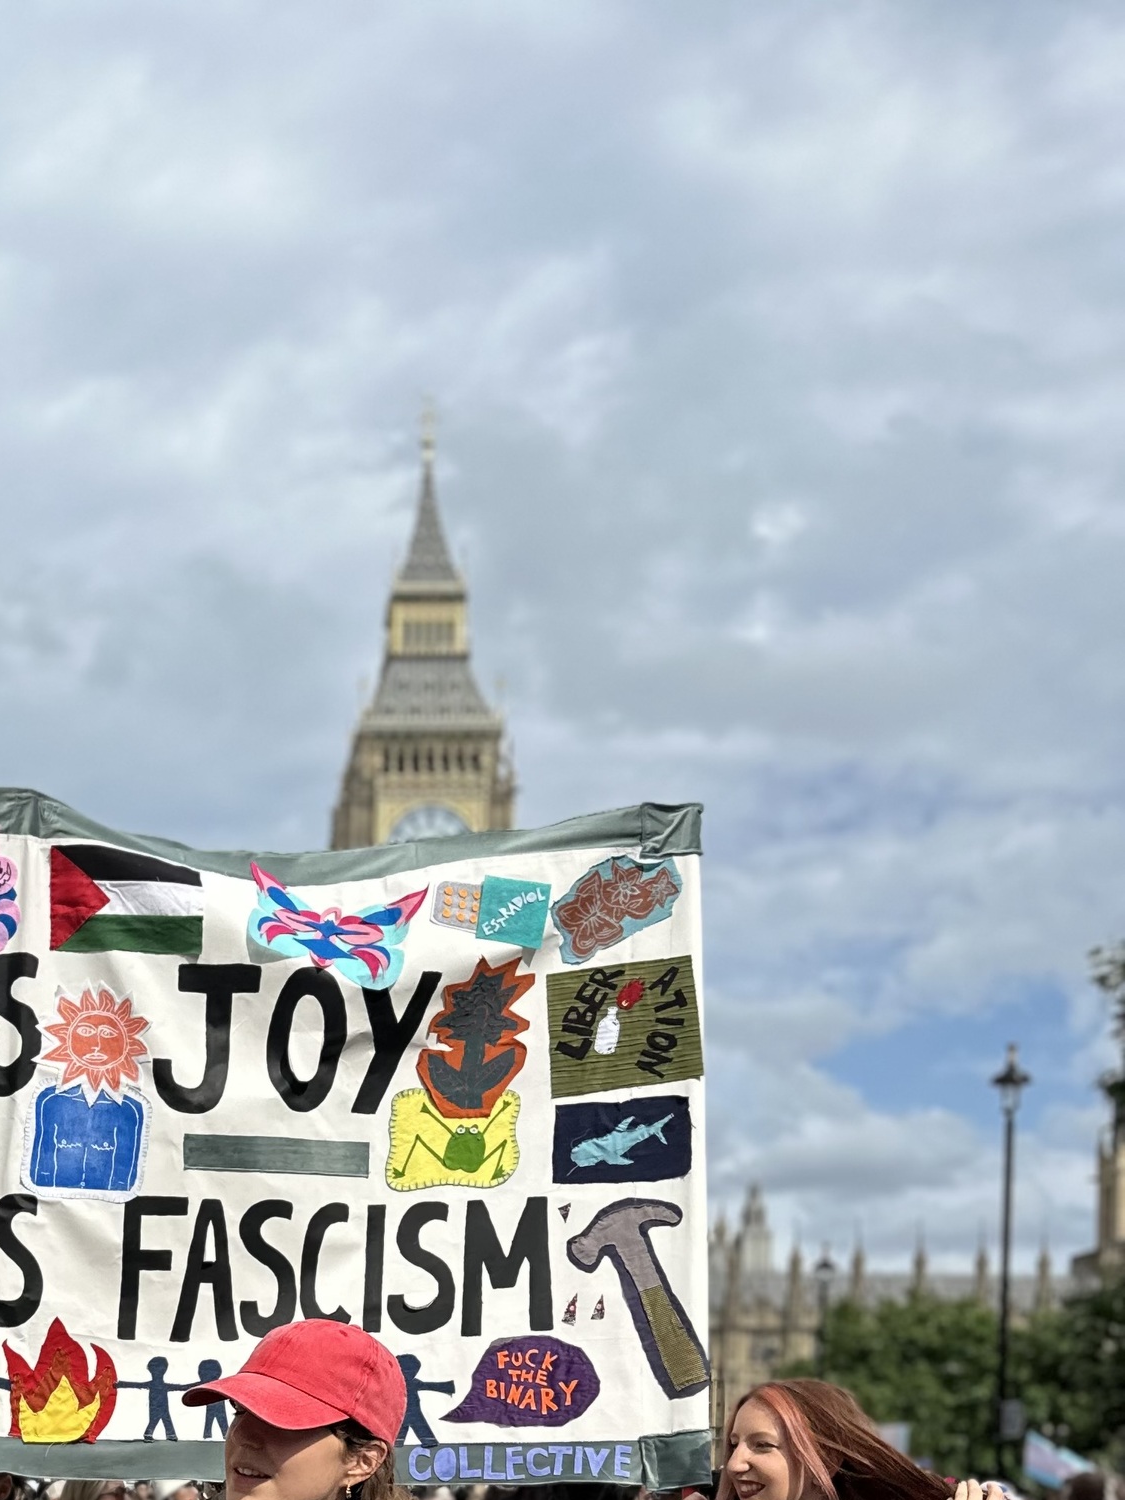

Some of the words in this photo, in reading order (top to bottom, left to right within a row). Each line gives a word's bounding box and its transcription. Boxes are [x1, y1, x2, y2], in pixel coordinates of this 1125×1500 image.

[481, 887, 546, 936] ESTRADIOL
[152, 963, 442, 1114] JOY
[117, 1196, 554, 1342] FASCISM
[496, 1349, 559, 1371] FUCK
[508, 1369, 548, 1385] THE
[485, 1379, 578, 1415] BINARY
[408, 1445, 633, 1481] COLLECTIVE
